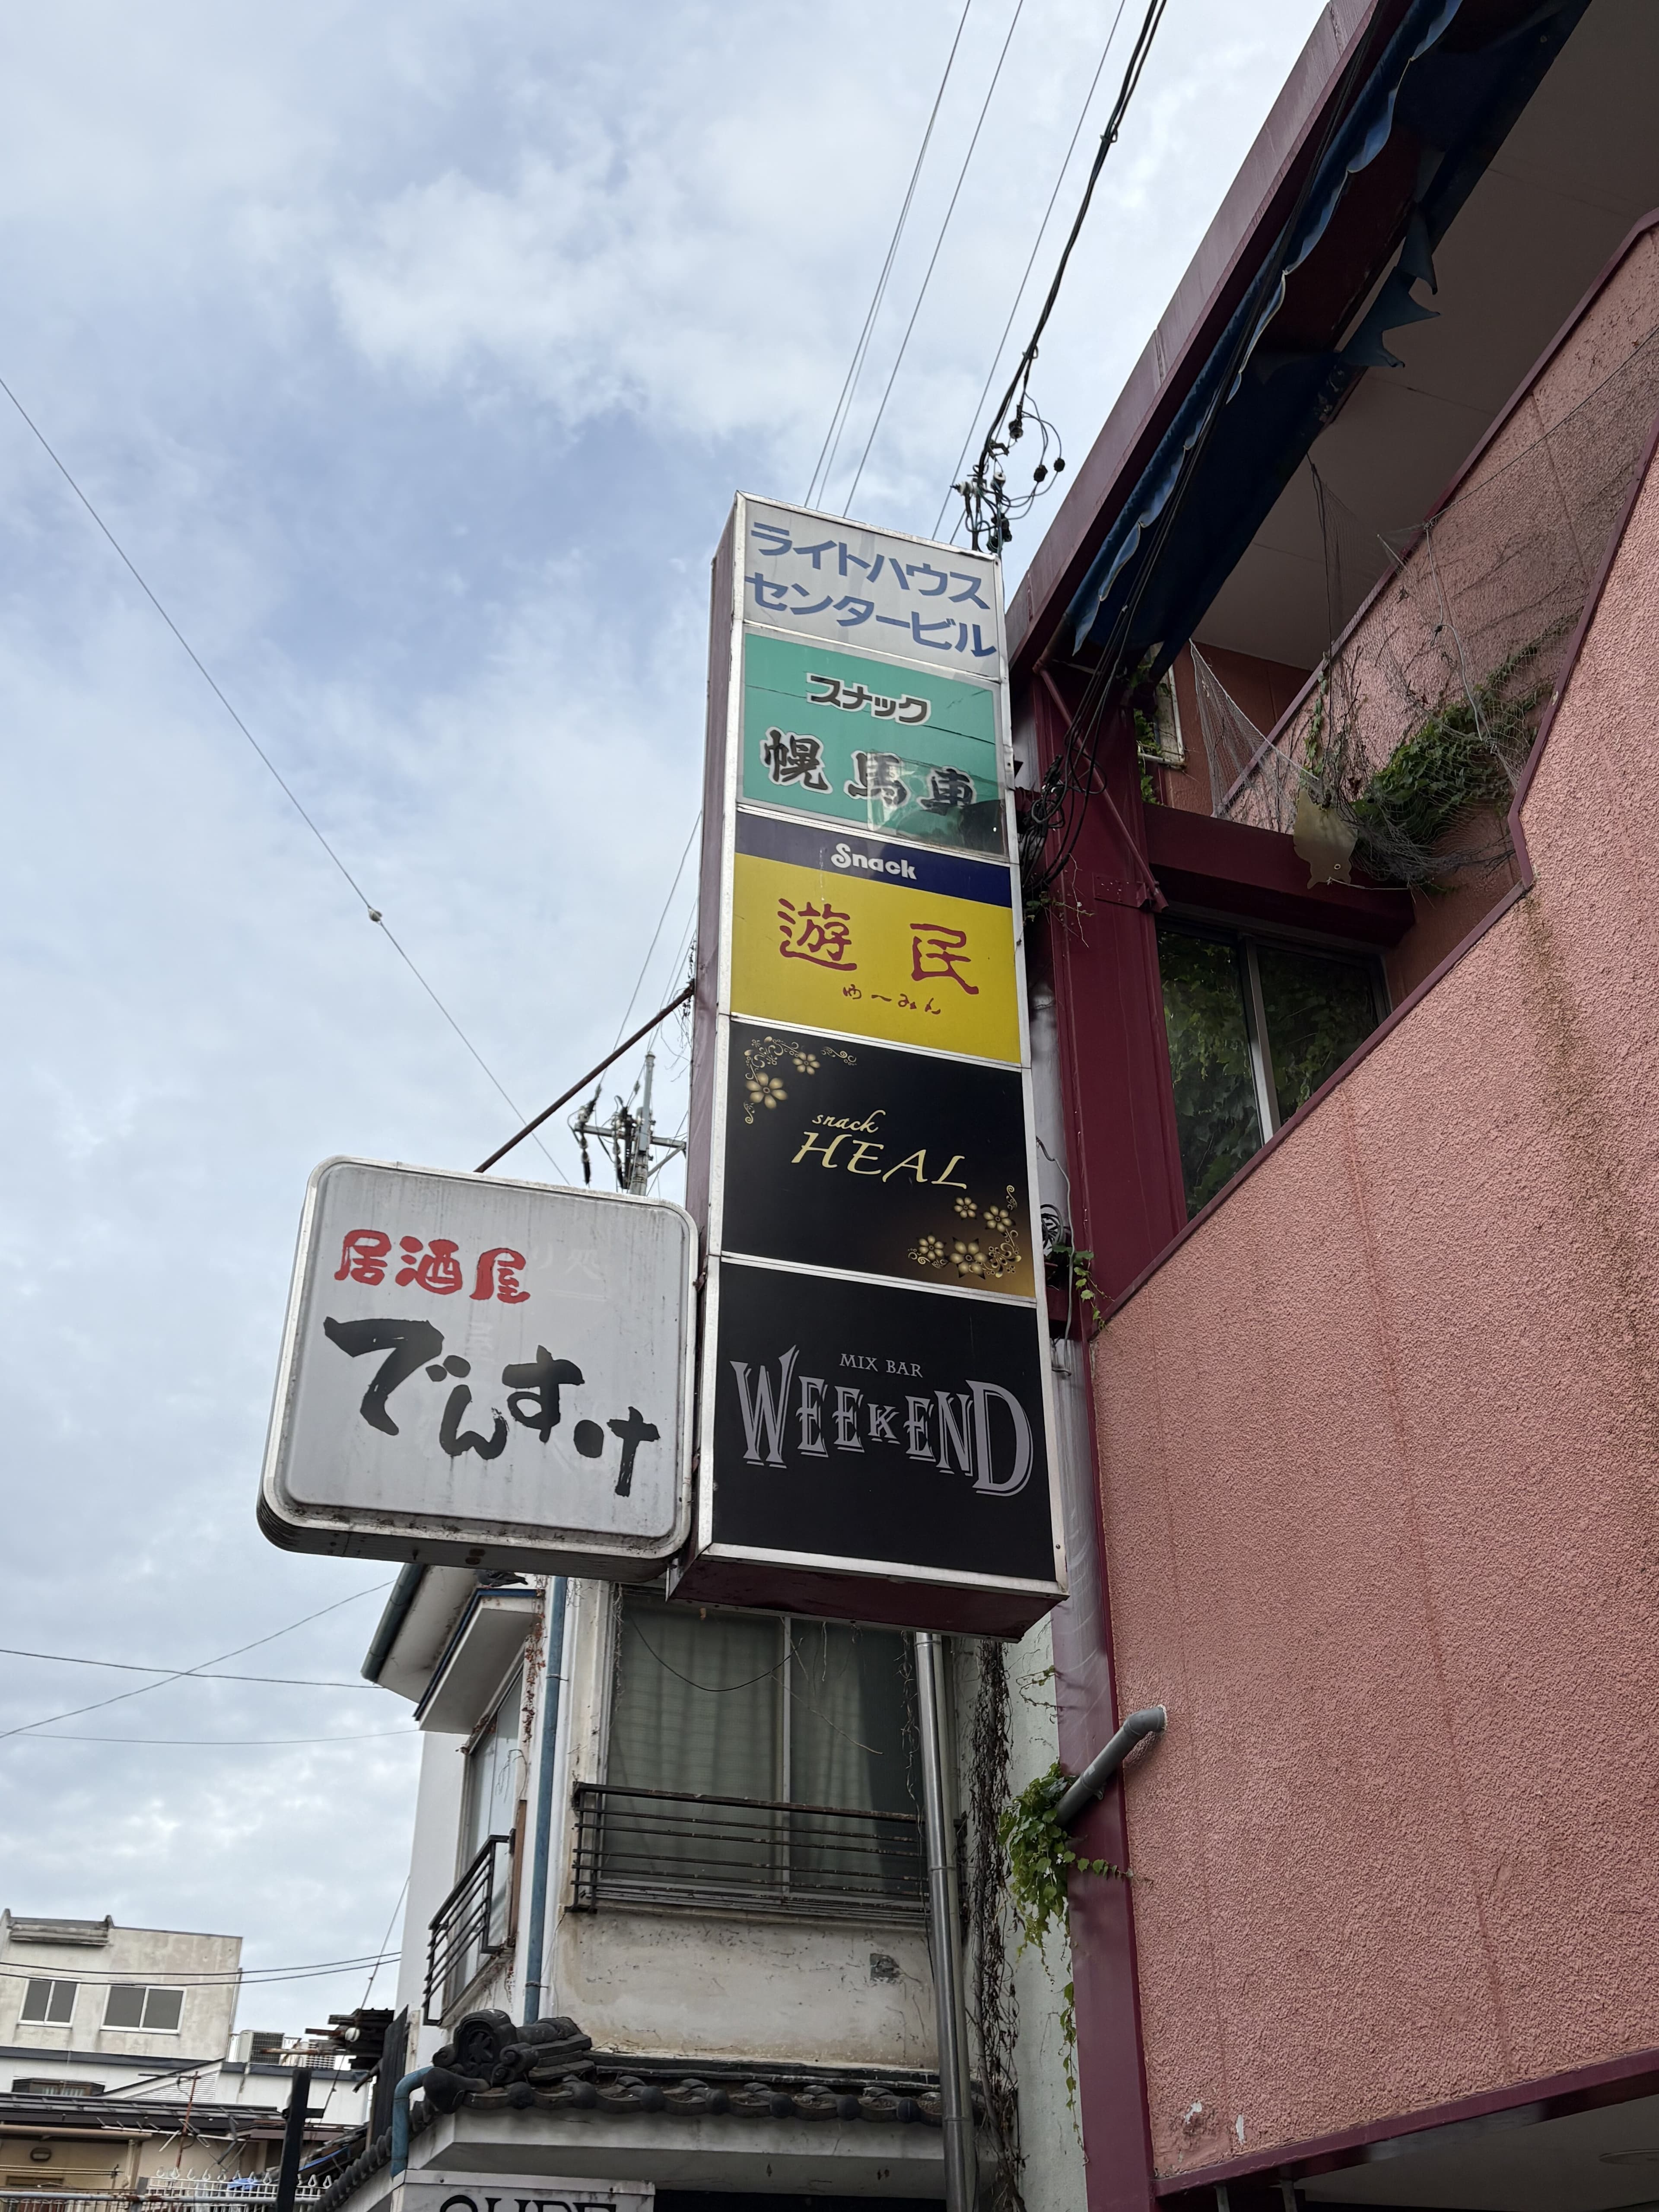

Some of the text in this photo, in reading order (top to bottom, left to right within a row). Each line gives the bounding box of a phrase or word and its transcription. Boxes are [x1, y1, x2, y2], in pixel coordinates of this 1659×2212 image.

[750, 522, 991, 609] ライトハウス
[745, 572, 996, 657] センタービル
[806, 673, 931, 726] スナック
[831, 843, 917, 880] Snack
[777, 898, 979, 995] 遊民
[812, 1109, 886, 1134] snack
[791, 1131, 967, 1190] HEAL
[334, 1229, 531, 1304] 居酒屋
[839, 1353, 923, 1378] MIX BAR
[323, 1316, 661, 1497] でんすけ
[730, 1344, 1034, 1497] WEEKEND
